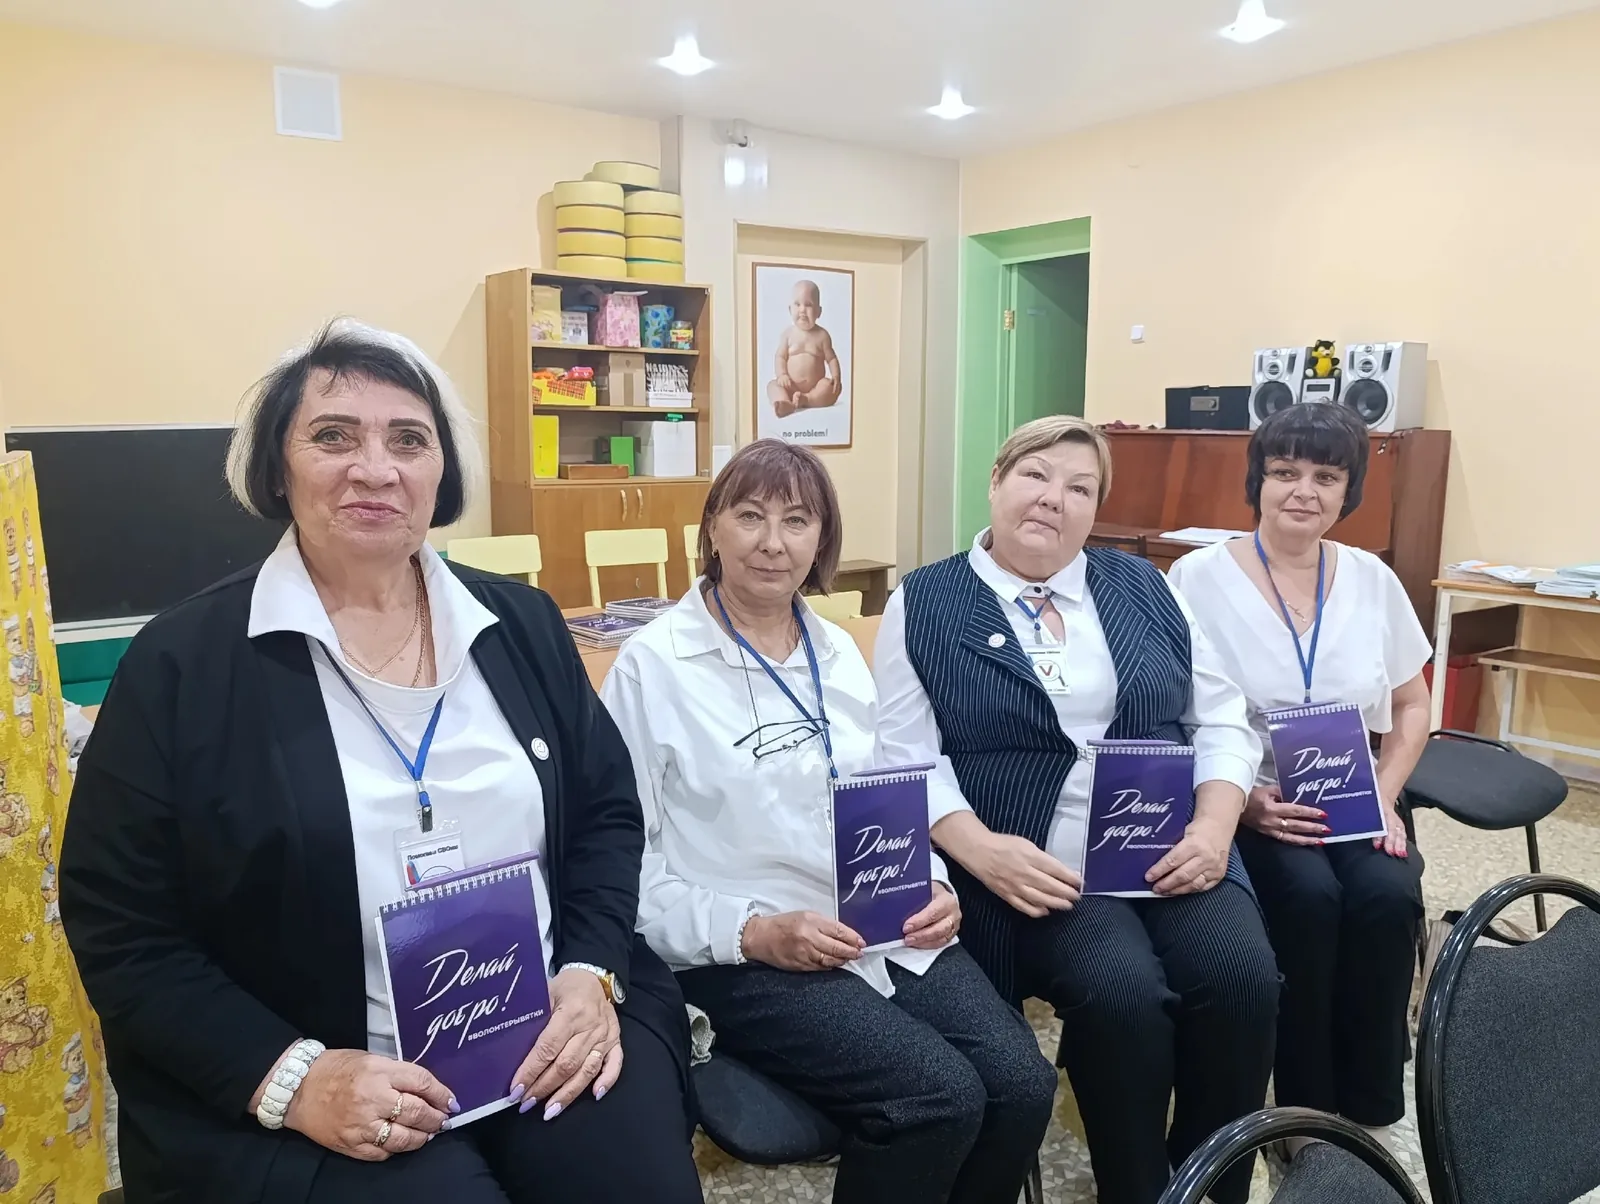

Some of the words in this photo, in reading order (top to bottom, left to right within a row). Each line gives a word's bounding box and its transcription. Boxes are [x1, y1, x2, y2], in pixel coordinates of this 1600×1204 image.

[794, 428, 829, 439] problem!
[1287, 746, 1355, 778] Делай
[1291, 762, 1357, 804] добро!
[1099, 788, 1176, 819] Делай
[845, 824, 916, 865] Делай
[1089, 812, 1173, 852] добро!
[841, 845, 917, 904] добро!
[412, 942, 519, 1011] Делай
[410, 964, 523, 1064] добро!
[467, 1009, 544, 1041] #ВОЛОНТЕРЫВЯТКИ
